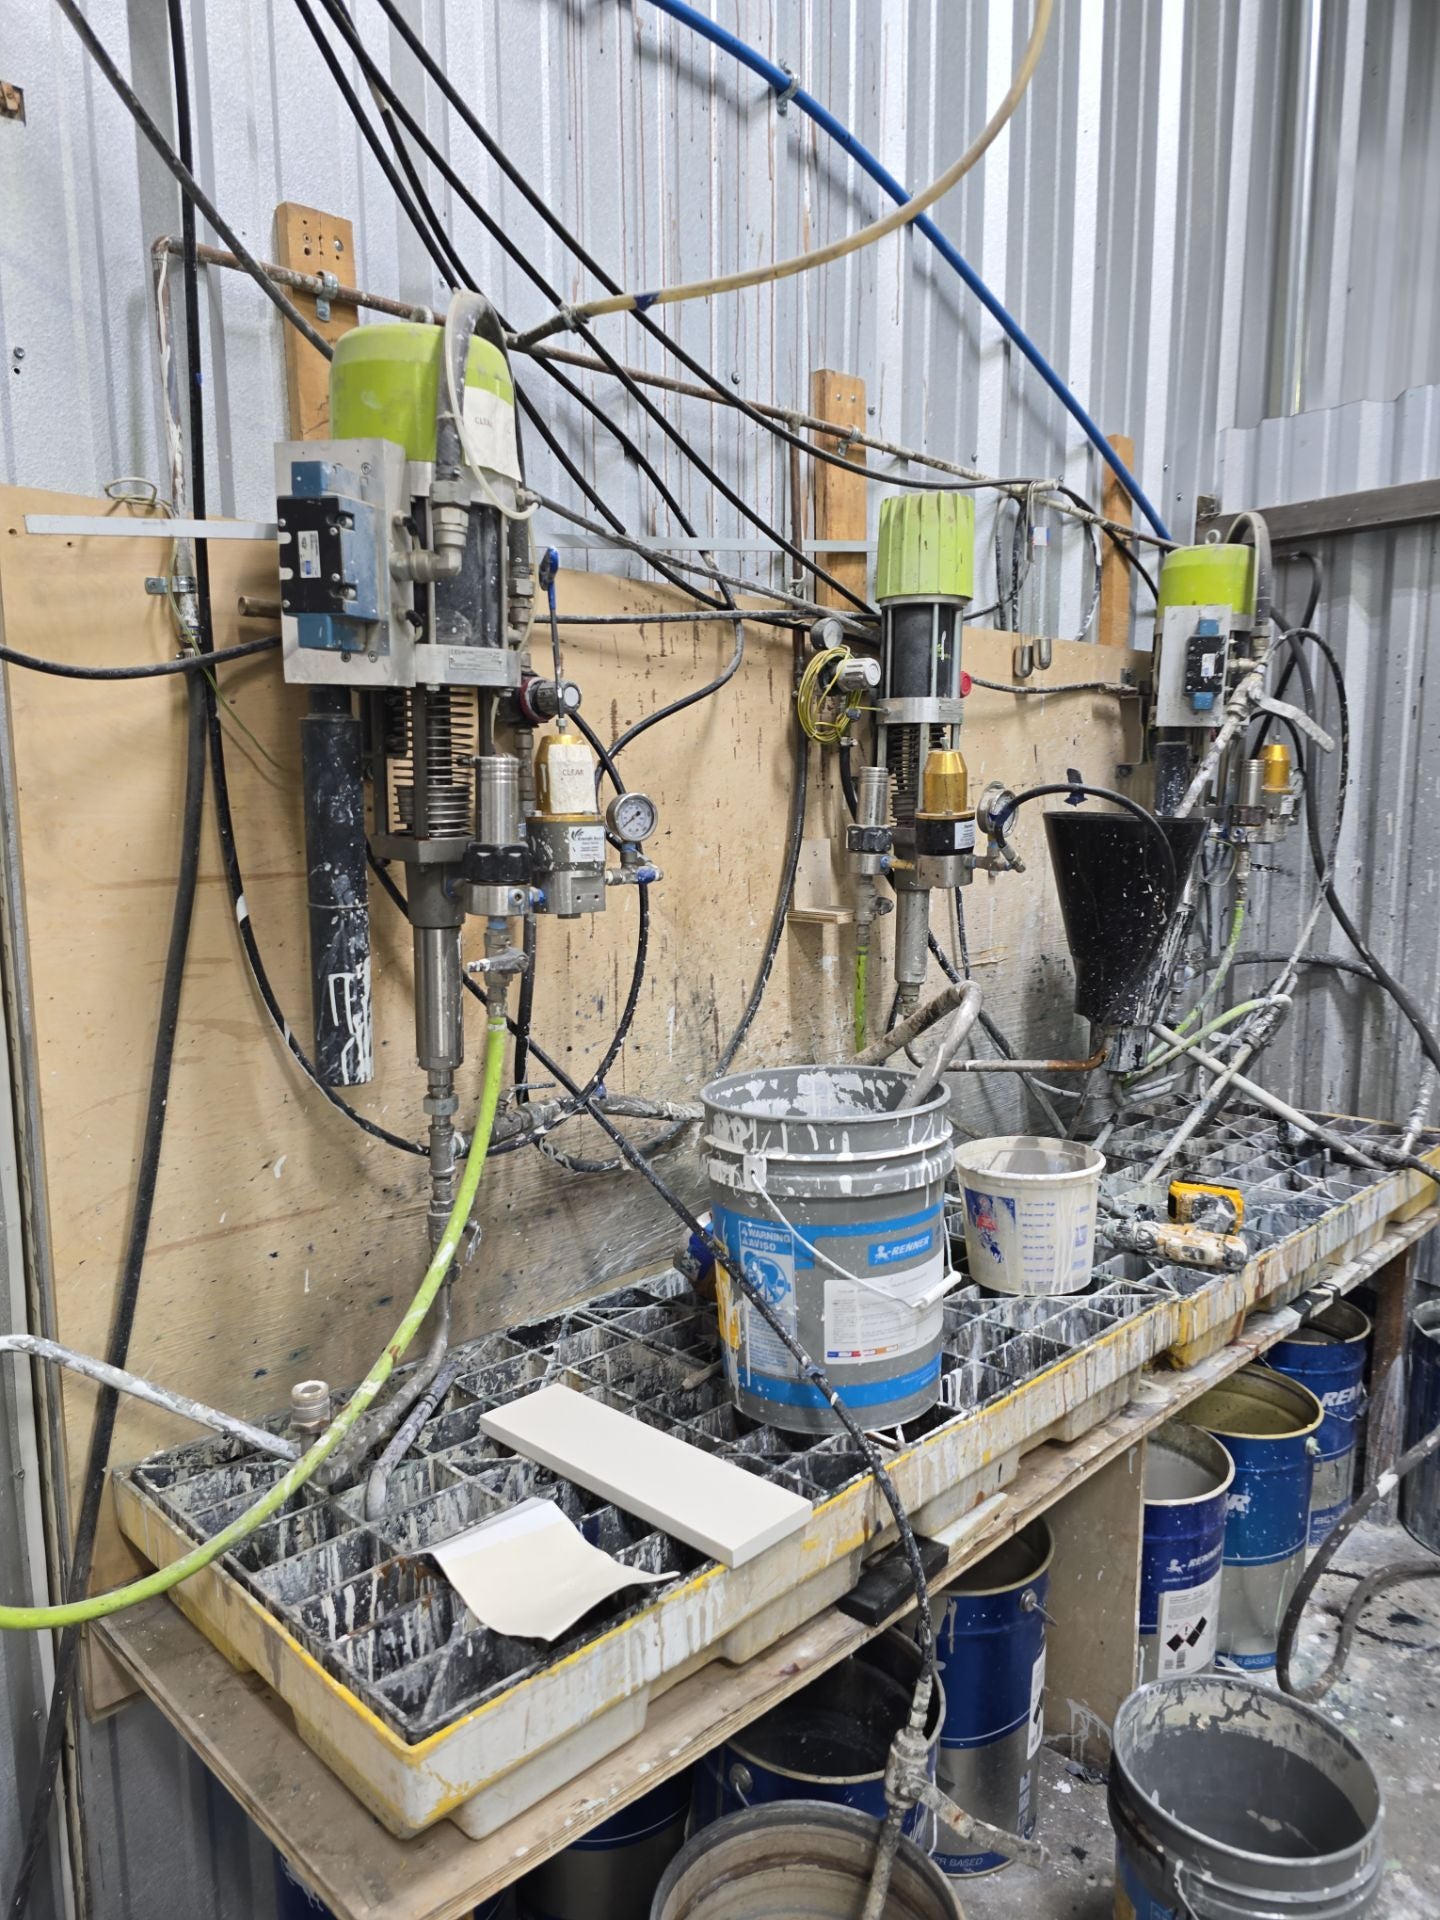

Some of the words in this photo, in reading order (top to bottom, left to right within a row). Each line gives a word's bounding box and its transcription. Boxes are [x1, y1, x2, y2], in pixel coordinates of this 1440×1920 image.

[562, 768, 584, 776] CLEAR
[748, 1228, 791, 1243] WARNING
[748, 1238, 776, 1251] AVISO
[891, 1235, 930, 1255] RENNER
[1244, 1656, 1272, 1665] BASED
[949, 1857, 984, 1867] BASED
